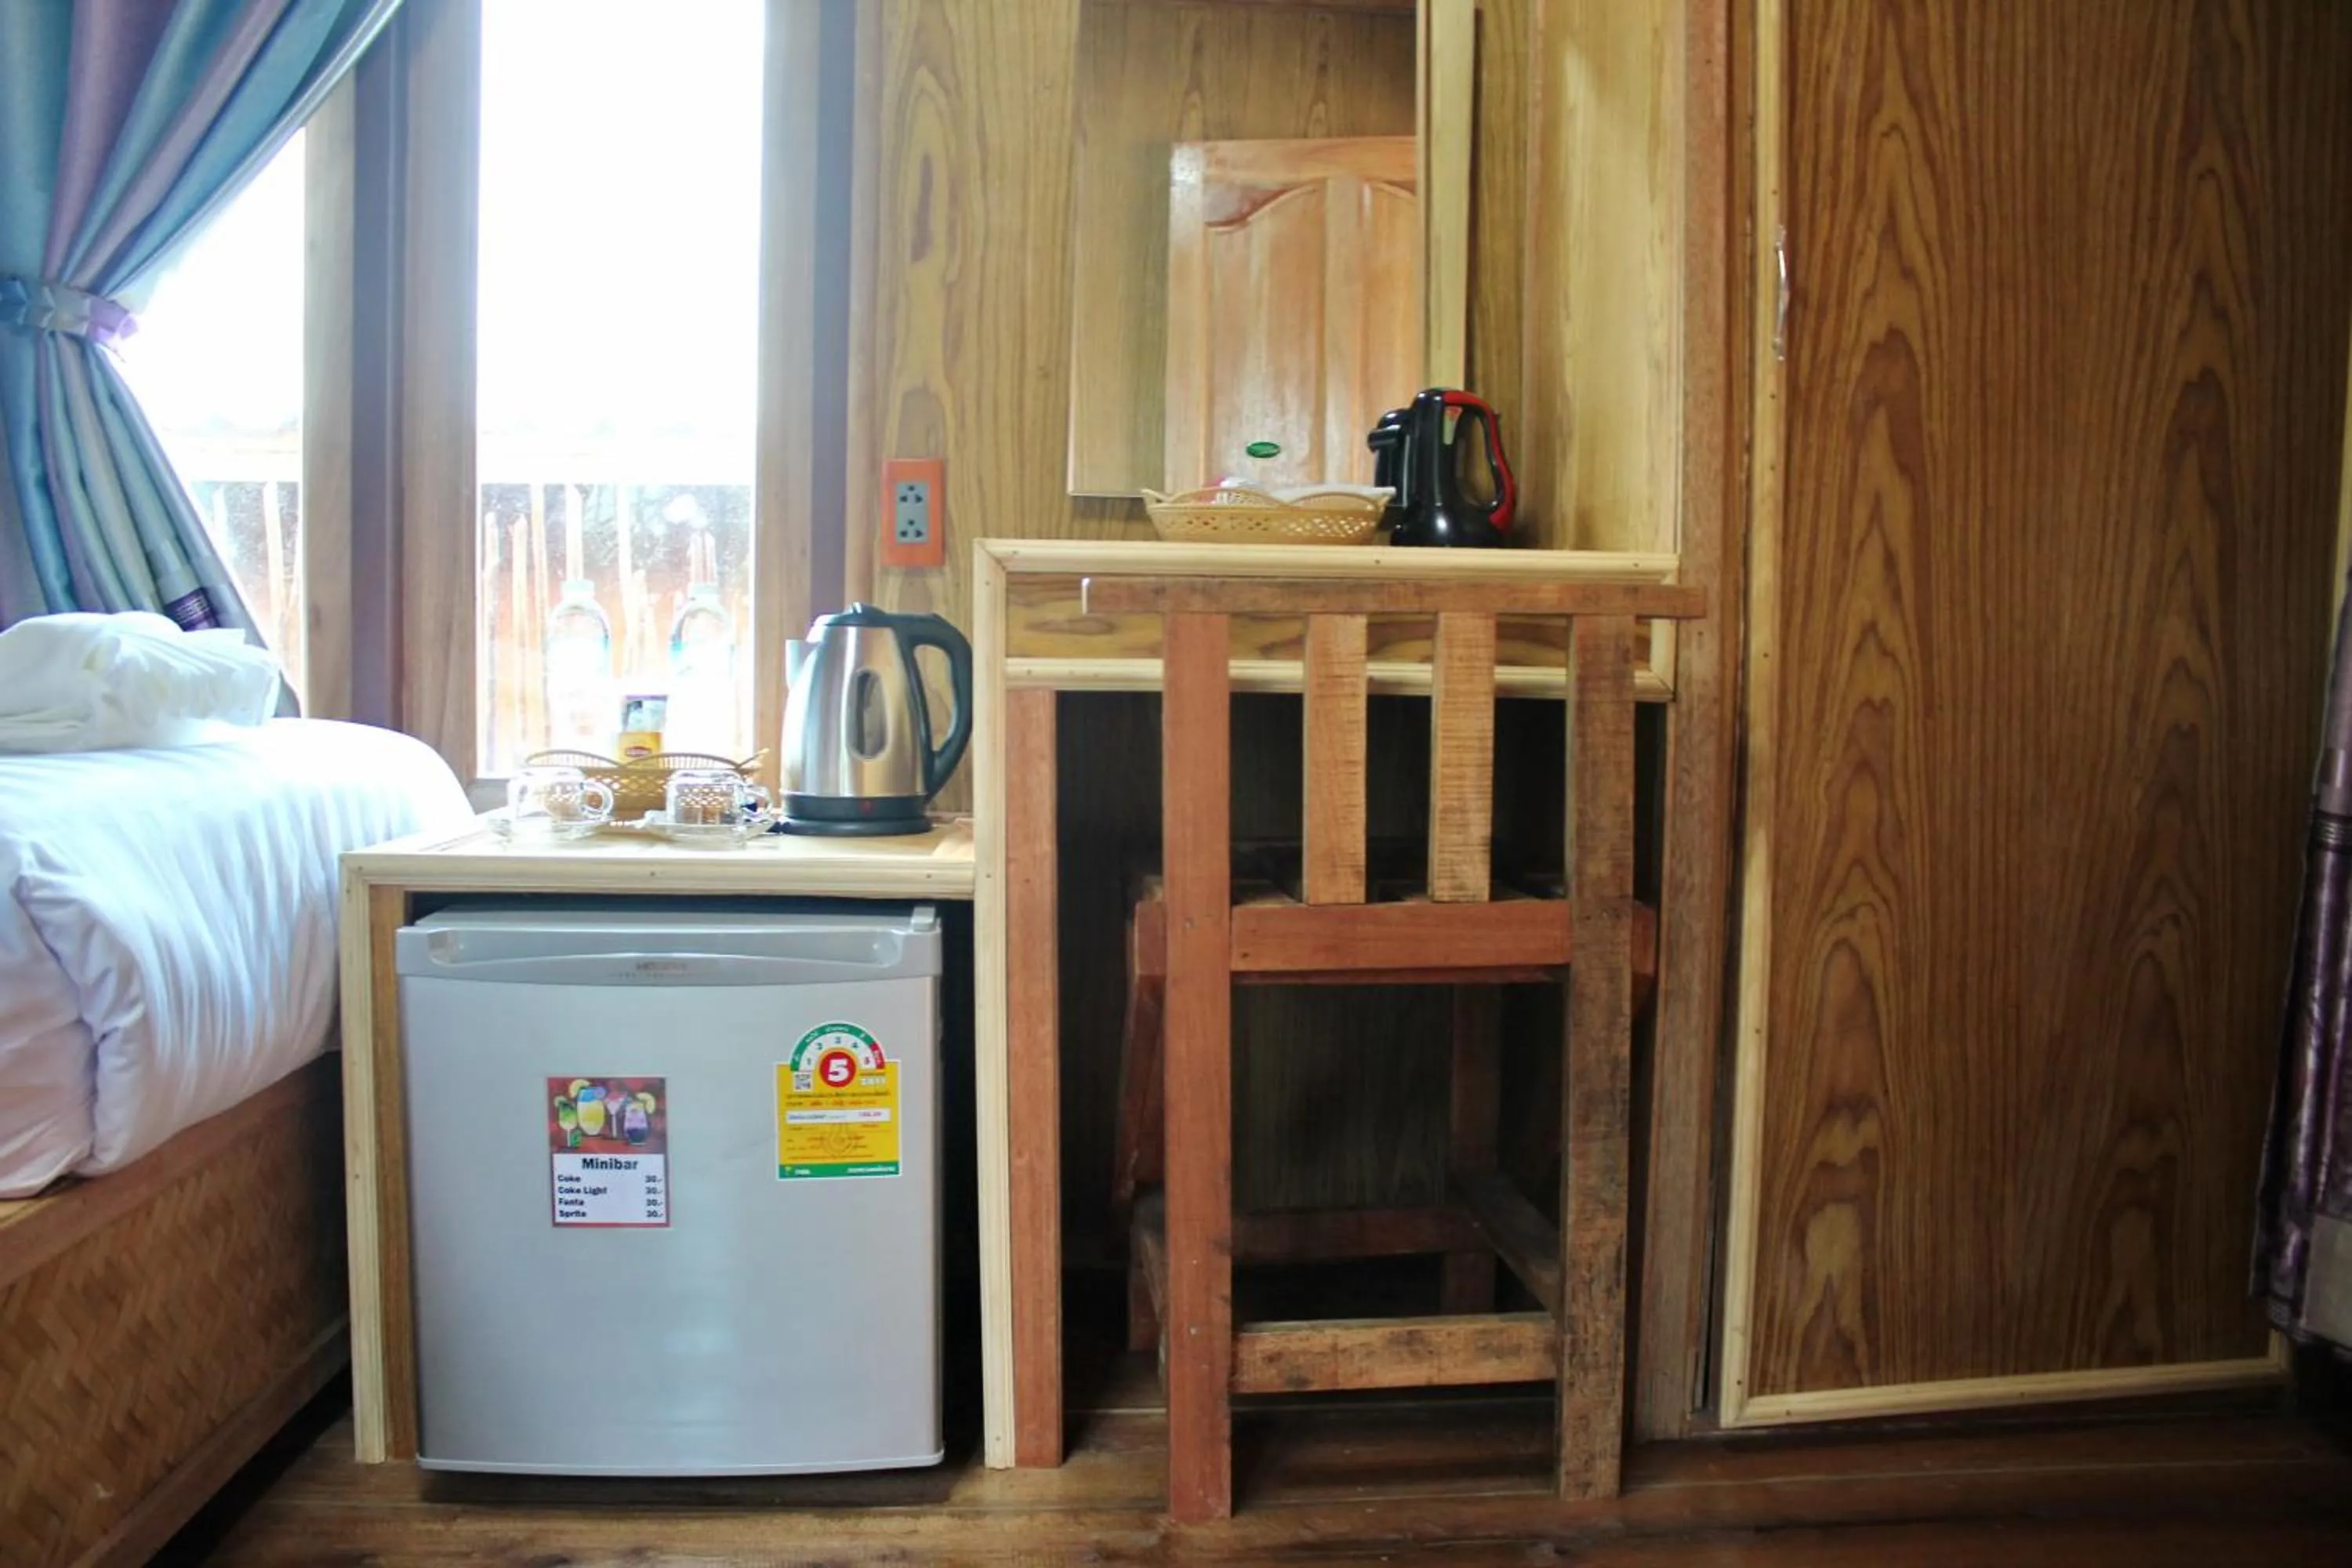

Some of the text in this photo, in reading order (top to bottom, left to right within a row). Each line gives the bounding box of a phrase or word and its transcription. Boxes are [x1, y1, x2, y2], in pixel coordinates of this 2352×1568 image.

[828, 1058, 850, 1082] 5
[582, 1158, 638, 1170] Minibar
[583, 1186, 608, 1196] Light
